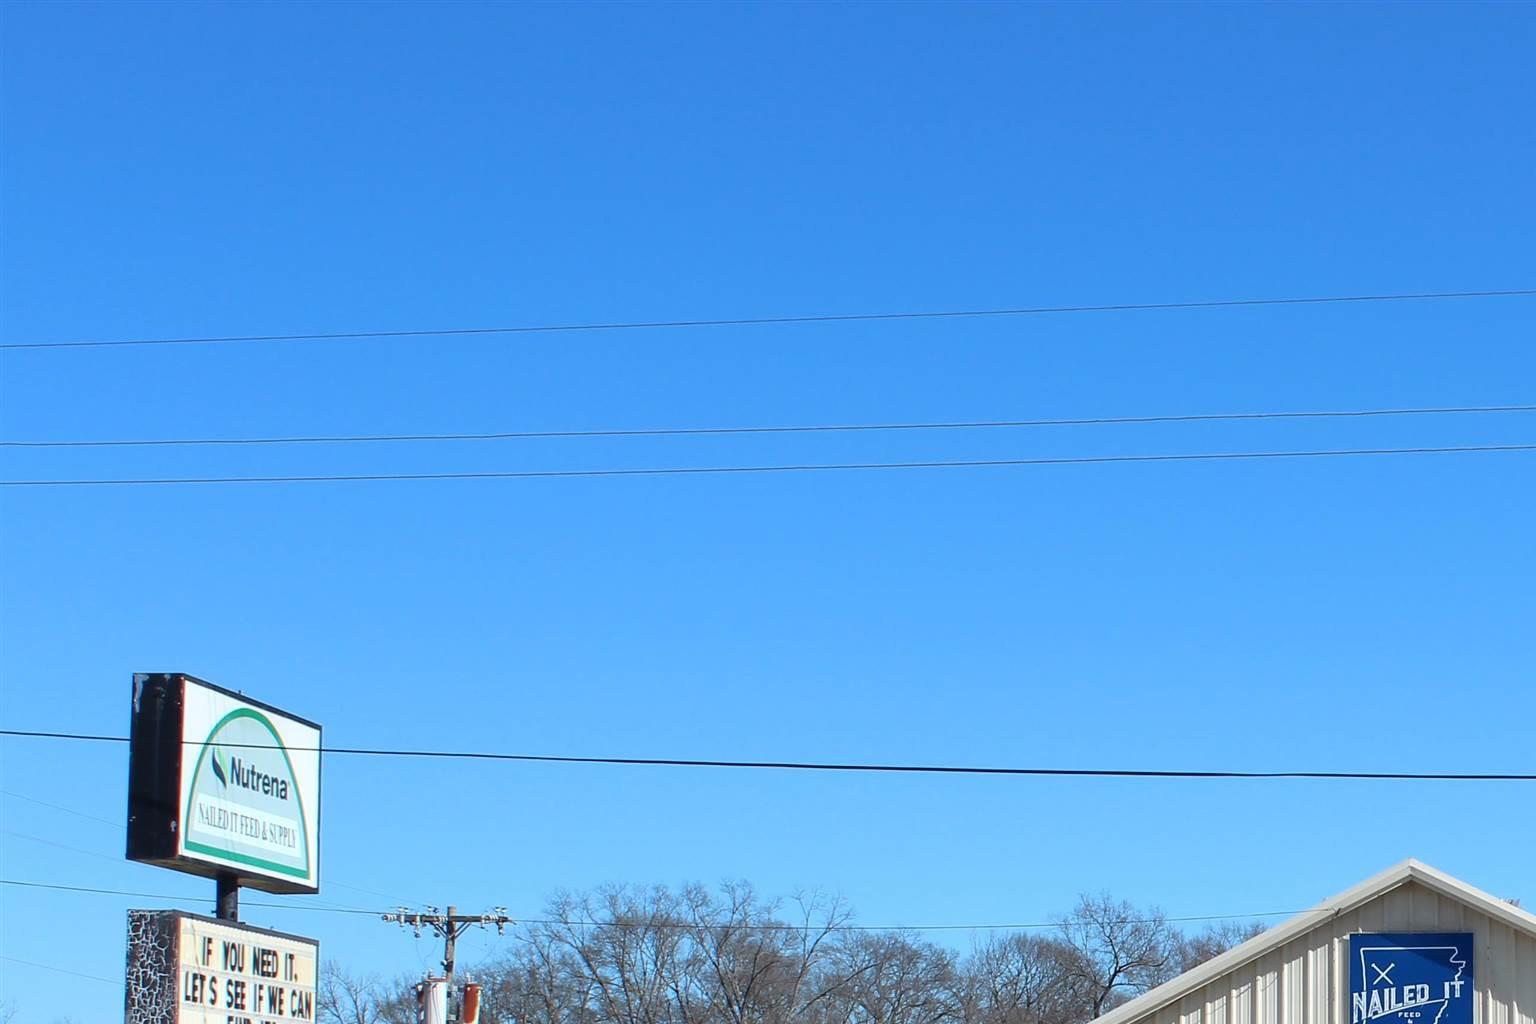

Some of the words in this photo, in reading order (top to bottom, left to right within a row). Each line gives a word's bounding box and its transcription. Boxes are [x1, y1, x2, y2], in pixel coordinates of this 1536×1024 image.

[231, 756, 288, 801] Nutrena
[199, 802, 230, 830] NAILED
[230, 811, 238, 833] IT
[240, 814, 260, 839] FEED
[262, 821, 268, 840] &
[269, 823, 297, 849] SUPPLY
[202, 936, 213, 966] IF
[223, 941, 246, 973] YOU
[252, 946, 279, 978] NEED
[226, 979, 246, 1010] SEE
[254, 984, 264, 1013] IF
[268, 986, 284, 1016] WE
[290, 989, 312, 1020] CAN
[1353, 983, 1430, 1024] NAILED
[1444, 981, 1464, 999] IT
